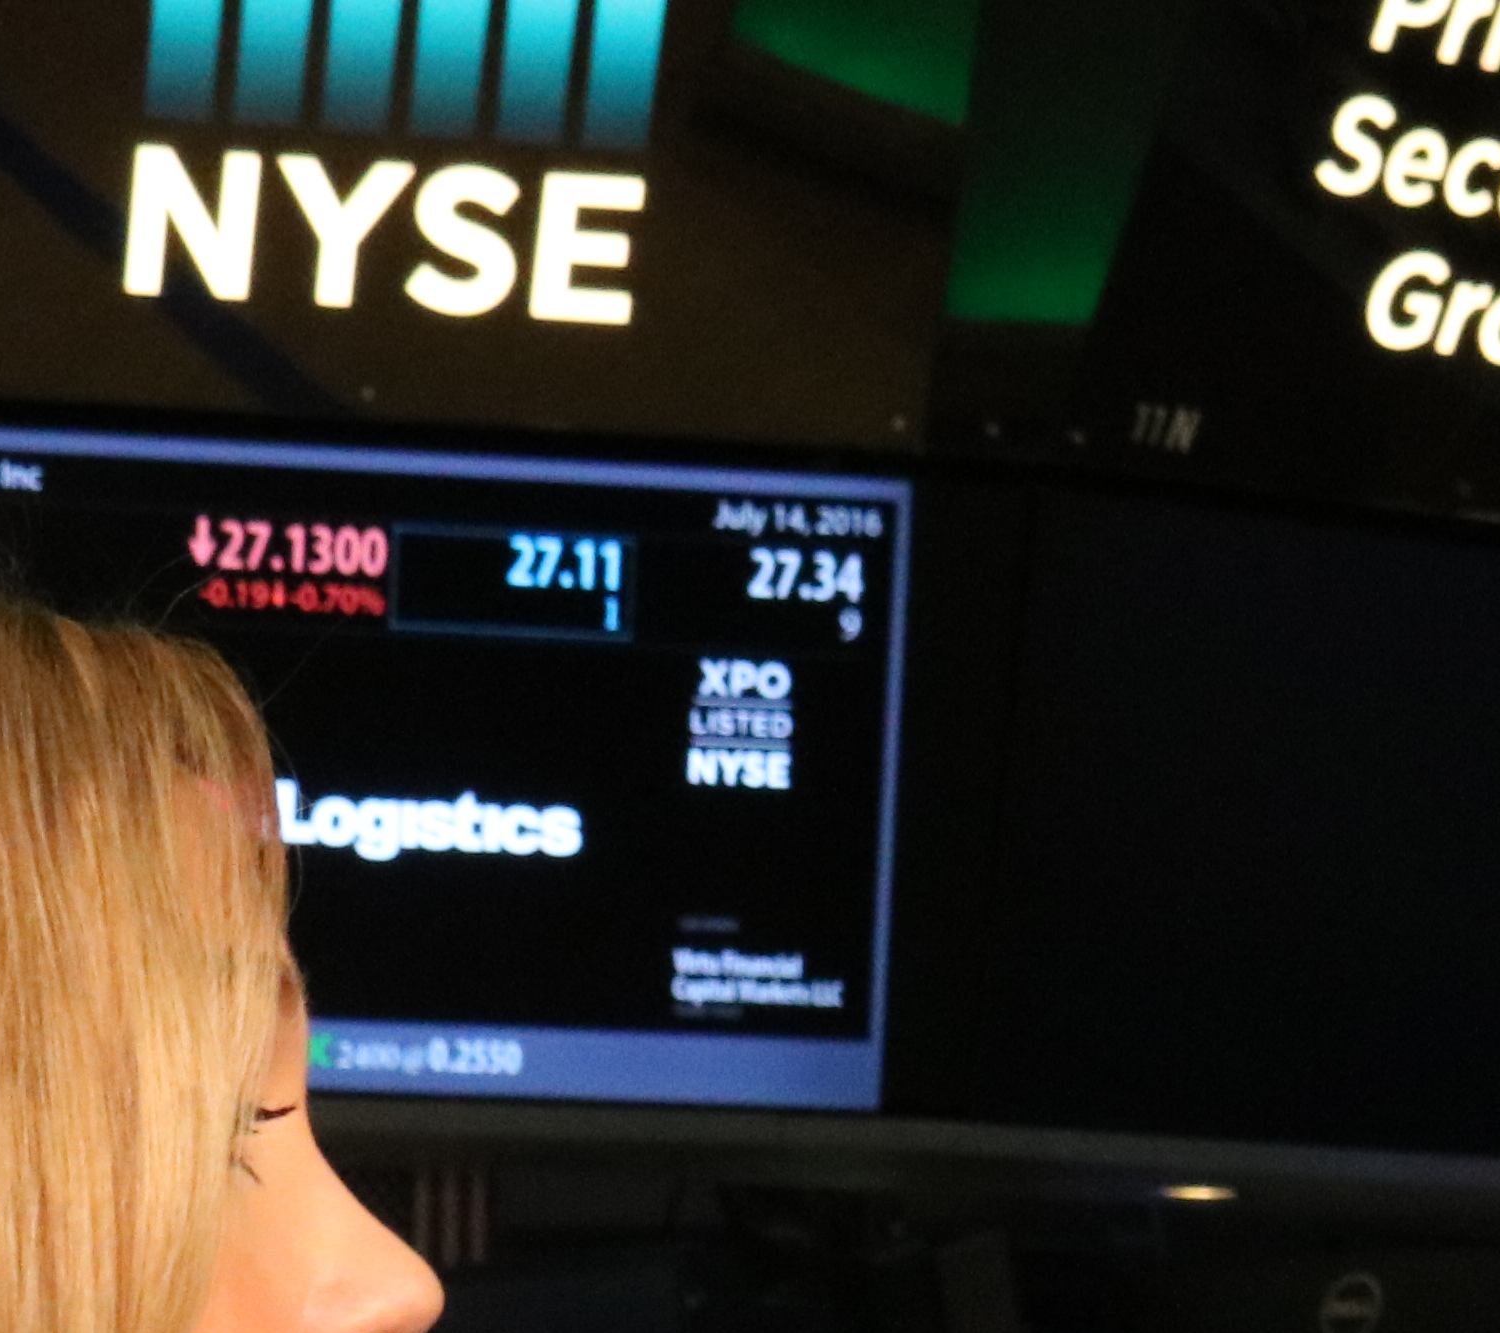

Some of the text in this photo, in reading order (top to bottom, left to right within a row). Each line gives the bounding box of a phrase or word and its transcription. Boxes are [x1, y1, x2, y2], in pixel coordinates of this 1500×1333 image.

[122, 142, 647, 326] NYSE
[713, 500, 768, 537] July
[815, 505, 884, 538] 2016
[219, 522, 388, 578] 27.1300
[506, 534, 623, 592] 27.11
[746, 547, 865, 602] 27.34
[697, 657, 793, 699] XPO
[689, 707, 794, 740] LISTED
[685, 747, 793, 790] NYSE
